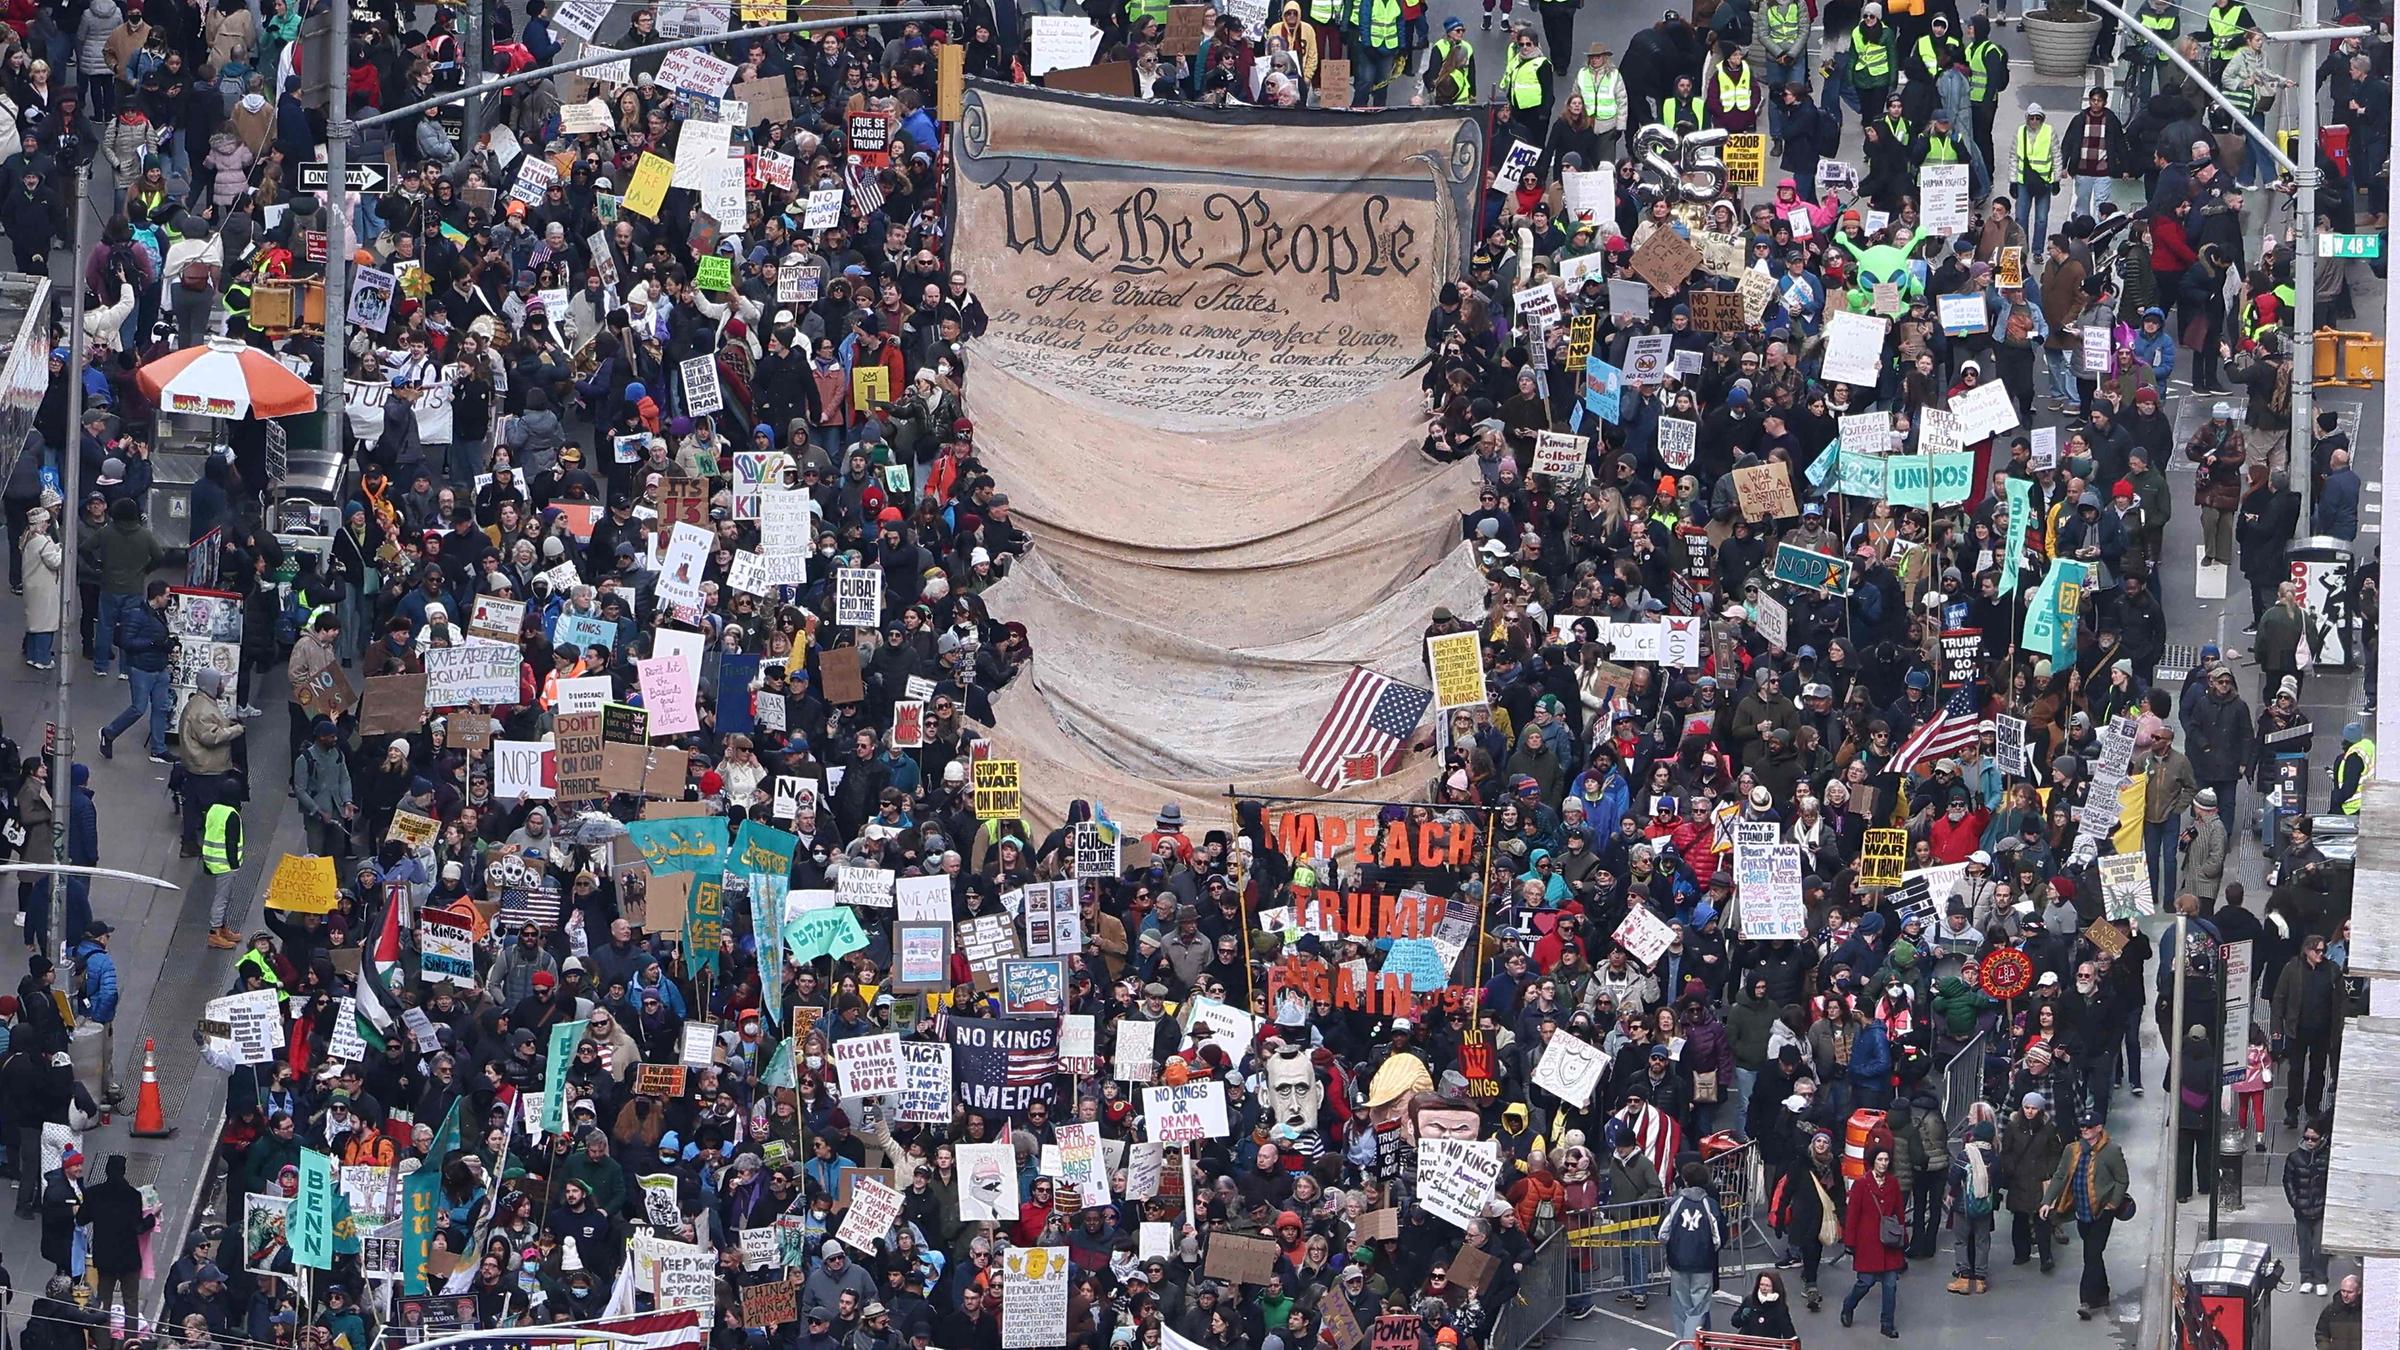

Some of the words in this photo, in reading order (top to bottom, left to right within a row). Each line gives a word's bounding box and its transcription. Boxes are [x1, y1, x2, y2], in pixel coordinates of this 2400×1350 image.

[692, 55, 728, 76] CRIMES
[852, 117, 872, 128] ¡QUE
[874, 117, 885, 127] SE
[851, 127, 885, 139] LARGUE
[852, 139, 884, 150] TRUMP
[760, 150, 779, 160] END
[1923, 179, 1943, 189] HUMAN
[1945, 177, 1967, 187] RIGHTS
[813, 192, 833, 203] NO
[980, 160, 1110, 263] We
[1110, 187, 1204, 274] the
[1202, 190, 1420, 303] People
[1709, 233, 1738, 246] PEACE
[2334, 238, 2344, 254] W
[2347, 237, 2364, 254] 48
[780, 280, 797, 290] NOT
[1025, 277, 1069, 307] of
[1062, 278, 1104, 303] the
[1111, 280, 1198, 308] United
[1194, 282, 1290, 315] States,
[1692, 295, 1708, 306] NO
[1716, 293, 1739, 306] ICE
[1520, 295, 1549, 311] FUCK
[1693, 308, 1708, 318] NO
[1715, 308, 1738, 319] WAR
[1573, 317, 1592, 327] NO
[1694, 319, 1708, 330] NO
[1712, 320, 1744, 332] KINGS
[988, 308, 1020, 322] in
[1027, 308, 1087, 333] order
[1098, 313, 1119, 334] to
[1114, 314, 1174, 341] form
[1193, 324, 1242, 340] more
[1236, 321, 1333, 351] perfect
[992, 330, 1085, 351] establish
[1182, 343, 1260, 363] insure
[1270, 345, 1357, 366] domestic
[1107, 357, 1133, 370] the
[1140, 362, 1210, 374] common
[1144, 376, 1187, 385] and
[690, 398, 719, 410] IRAN
[1844, 424, 1885, 436] OUTRAGE
[1537, 450, 1582, 462] Colbert
[1663, 450, 1692, 466] HISTORY
[1543, 462, 1575, 473] 2028
[1747, 468, 1773, 482] WAR
[1894, 465, 1969, 489] UNIDOS
[668, 479, 702, 496] ITS
[1754, 480, 1772, 491] NOT
[1747, 489, 1791, 504] SUBSTITUTE
[175, 501, 182, 510] A
[663, 498, 702, 523] 13
[1685, 535, 1708, 545] TRUMP
[1688, 546, 1708, 556] MUST
[1693, 557, 1704, 566] GO
[840, 579, 876, 598] CUBA!
[485, 600, 515, 611] HISTORY
[840, 598, 857, 609] END
[859, 598, 875, 611] THE
[840, 610, 875, 620] BLOCKADE!
[576, 621, 602, 634] KINGS
[1612, 625, 1632, 637] NO
[1635, 638, 1654, 649] ICE
[1941, 635, 1981, 648] TRUMP
[427, 650, 457, 667] WE
[460, 649, 488, 664] ARE
[1946, 647, 1978, 659] MUST
[1955, 659, 1971, 669] GO
[428, 669, 481, 688] EQUAL
[428, 687, 454, 702] THE
[1454, 691, 1479, 702] KINGS
[760, 697, 783, 712] WAR
[900, 706, 918, 720] NO
[560, 736, 605, 753] REIGN
[562, 759, 579, 773] ON
[581, 754, 603, 770] OUR
[975, 762, 998, 776] STOP
[999, 762, 1017, 775] THE
[560, 778, 600, 794] PARADE
[976, 776, 1018, 788] WAR
[977, 791, 994, 810] ON
[995, 790, 1019, 810] IRAN!
[1739, 823, 1763, 832] MAY
[1260, 807, 1476, 868] IMPEACH
[1738, 832, 1761, 842] STAND
[1764, 832, 1774, 841] UP
[1865, 832, 1887, 843] STOP
[1888, 832, 1905, 843] THE
[1078, 850, 1097, 862] END
[1098, 849, 1116, 861] THE
[1772, 846, 1798, 857] MAGA
[1864, 843, 1904, 856] WAR
[1077, 861, 1115, 872] BLOCKADE!
[1862, 860, 1876, 878] ON
[1876, 858, 1903, 878] IRAN!
[843, 868, 884, 879] TRUMP
[840, 879, 891, 894] MURDERS
[901, 892, 921, 907] WE
[926, 888, 948, 903] ARE
[1290, 884, 1447, 939] TRUMP
[1518, 913, 1535, 936] I
[1746, 922, 1776, 935] LUKE
[432, 923, 465, 940] KINGS
[424, 957, 450, 971] SINCE
[450, 961, 471, 977] 1776
[1286, 955, 1413, 1020] AGAIN
[1206, 1010, 1234, 1024] EPSTEIN
[956, 1026, 985, 1047] NO
[992, 1028, 1051, 1049] KINGS
[1463, 1030, 1483, 1045] NO
[342, 1047, 362, 1058] You?
[837, 1039, 893, 1060] REGIME
[850, 1069, 884, 1079] STARTS
[887, 1066, 898, 1076] AT
[851, 1075, 898, 1092] HOME
[918, 1079, 941, 1090] NOT
[900, 1092, 921, 1101] THE
[1155, 1087, 1171, 1101] NO
[1172, 1084, 1208, 1100] KINGS
[905, 1101, 918, 1109] OF
[920, 1101, 940, 1110] THE
[1172, 1100, 1188, 1113] OR
[901, 1110, 945, 1121] NATION
[1161, 1114, 1200, 1127] DRAMA
[1057, 1125, 1084, 1139] SUPER
[1160, 1127, 1205, 1141] QUEENS
[1058, 1136, 1096, 1149] CALLOUS
[1062, 1160, 1091, 1172] RACIST
[1450, 1142, 1461, 1160] NO
[1462, 1148, 1498, 1178] KINGS
[1453, 1165, 1493, 1192] America!
[862, 1180, 895, 1200] CLIMATE
[1431, 1180, 1456, 1200] Statue
[853, 1200, 862, 1209] IS
[865, 1197, 898, 1216] CHANGE
[850, 1212, 886, 1234] TRUMP'S
[742, 1230, 772, 1240] LAWS
[838, 1225, 855, 1240] ARE
[746, 1241, 768, 1249] NOT
[660, 1256, 690, 1271] KEEP
[668, 1272, 712, 1284] CROWN
[1047, 1271, 1064, 1281] OFF
[744, 1281, 794, 1299] CHINGA
[1374, 1318, 1421, 1341] POWER
